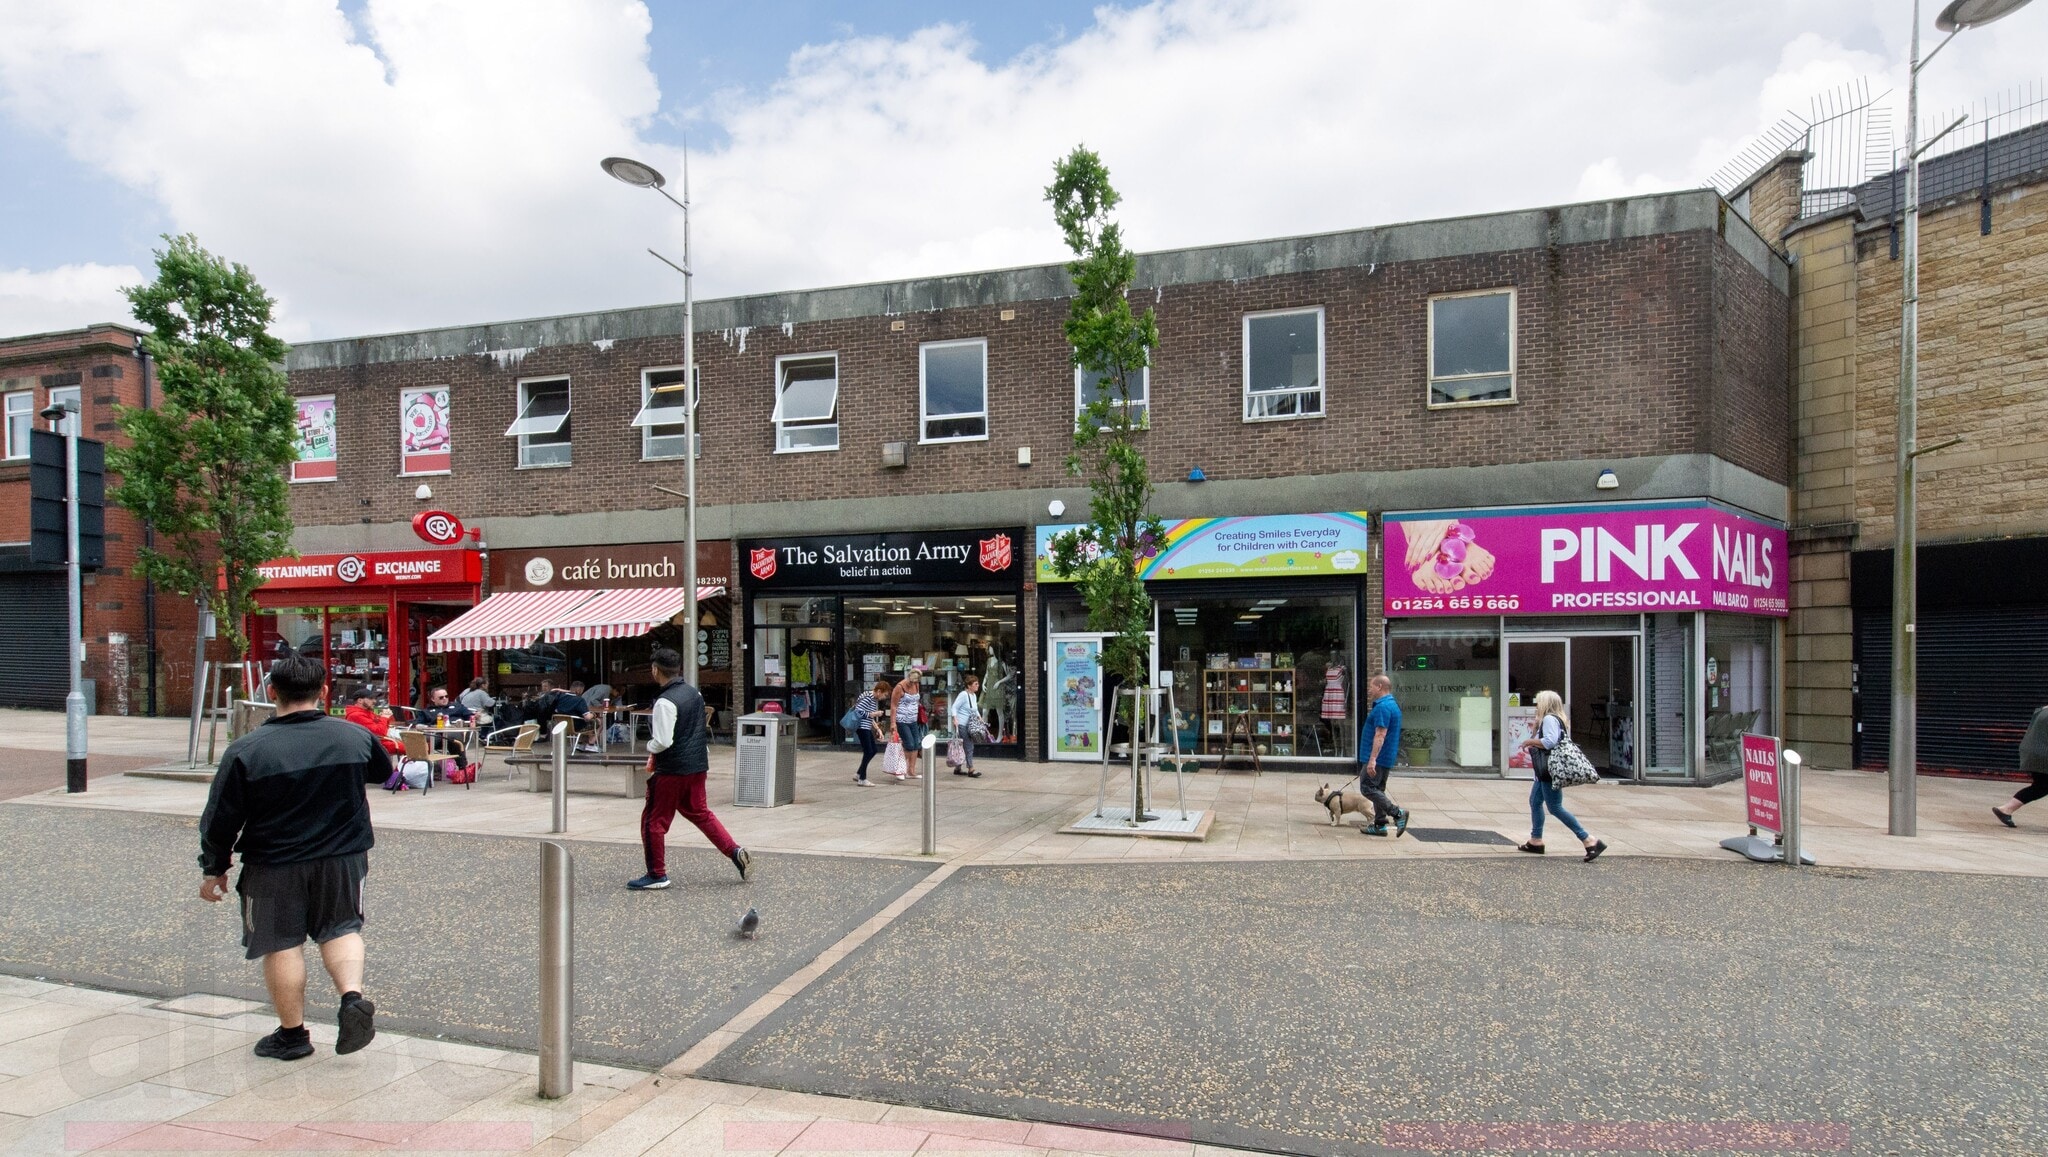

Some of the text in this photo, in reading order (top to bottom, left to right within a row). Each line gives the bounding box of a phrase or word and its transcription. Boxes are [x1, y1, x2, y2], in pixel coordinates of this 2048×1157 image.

[315, 435, 329, 446] CASH
[1215, 528, 1341, 541] Creating Smiles Everyday
[783, 541, 972, 566] The Salvation Army
[986, 541, 996, 552] THE
[1217, 539, 1338, 551] for Children with Cancer
[1541, 522, 1700, 584] PINK
[756, 551, 766, 561] THE
[1713, 523, 1773, 589] NAILS
[257, 565, 335, 579] ERTAINMENT
[375, 560, 441, 575] EXCHANGE
[562, 556, 676, 580] café brunch
[840, 566, 912, 577] belief in action
[1391, 599, 1445, 610] 01254
[1552, 590, 1701, 608] PROFESSIONAL
[1713, 590, 1749, 608] NAIL BAR CO
[1753, 596, 1768, 608] 01254
[1745, 748, 1775, 767] NAILS
[1750, 768, 1773, 785] OPEN
